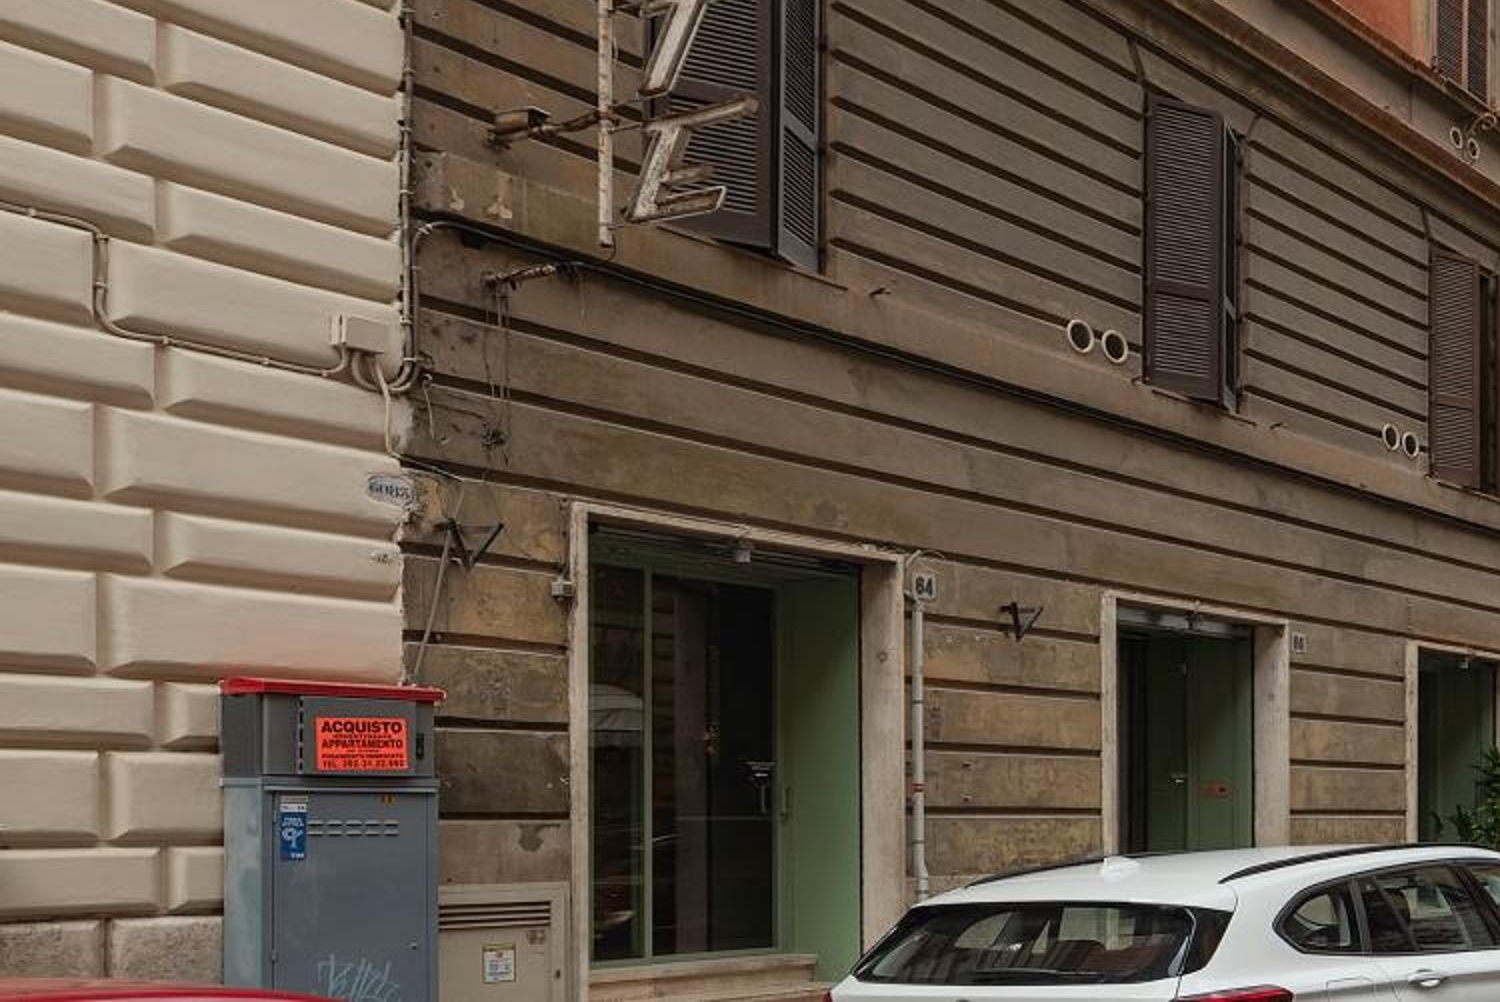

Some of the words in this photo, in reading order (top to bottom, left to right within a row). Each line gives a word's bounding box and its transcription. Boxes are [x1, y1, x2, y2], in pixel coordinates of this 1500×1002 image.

[916, 575, 933, 596] 64
[321, 721, 402, 733] ACQUISTO
[321, 739, 403, 749] APPARTAMENTO
